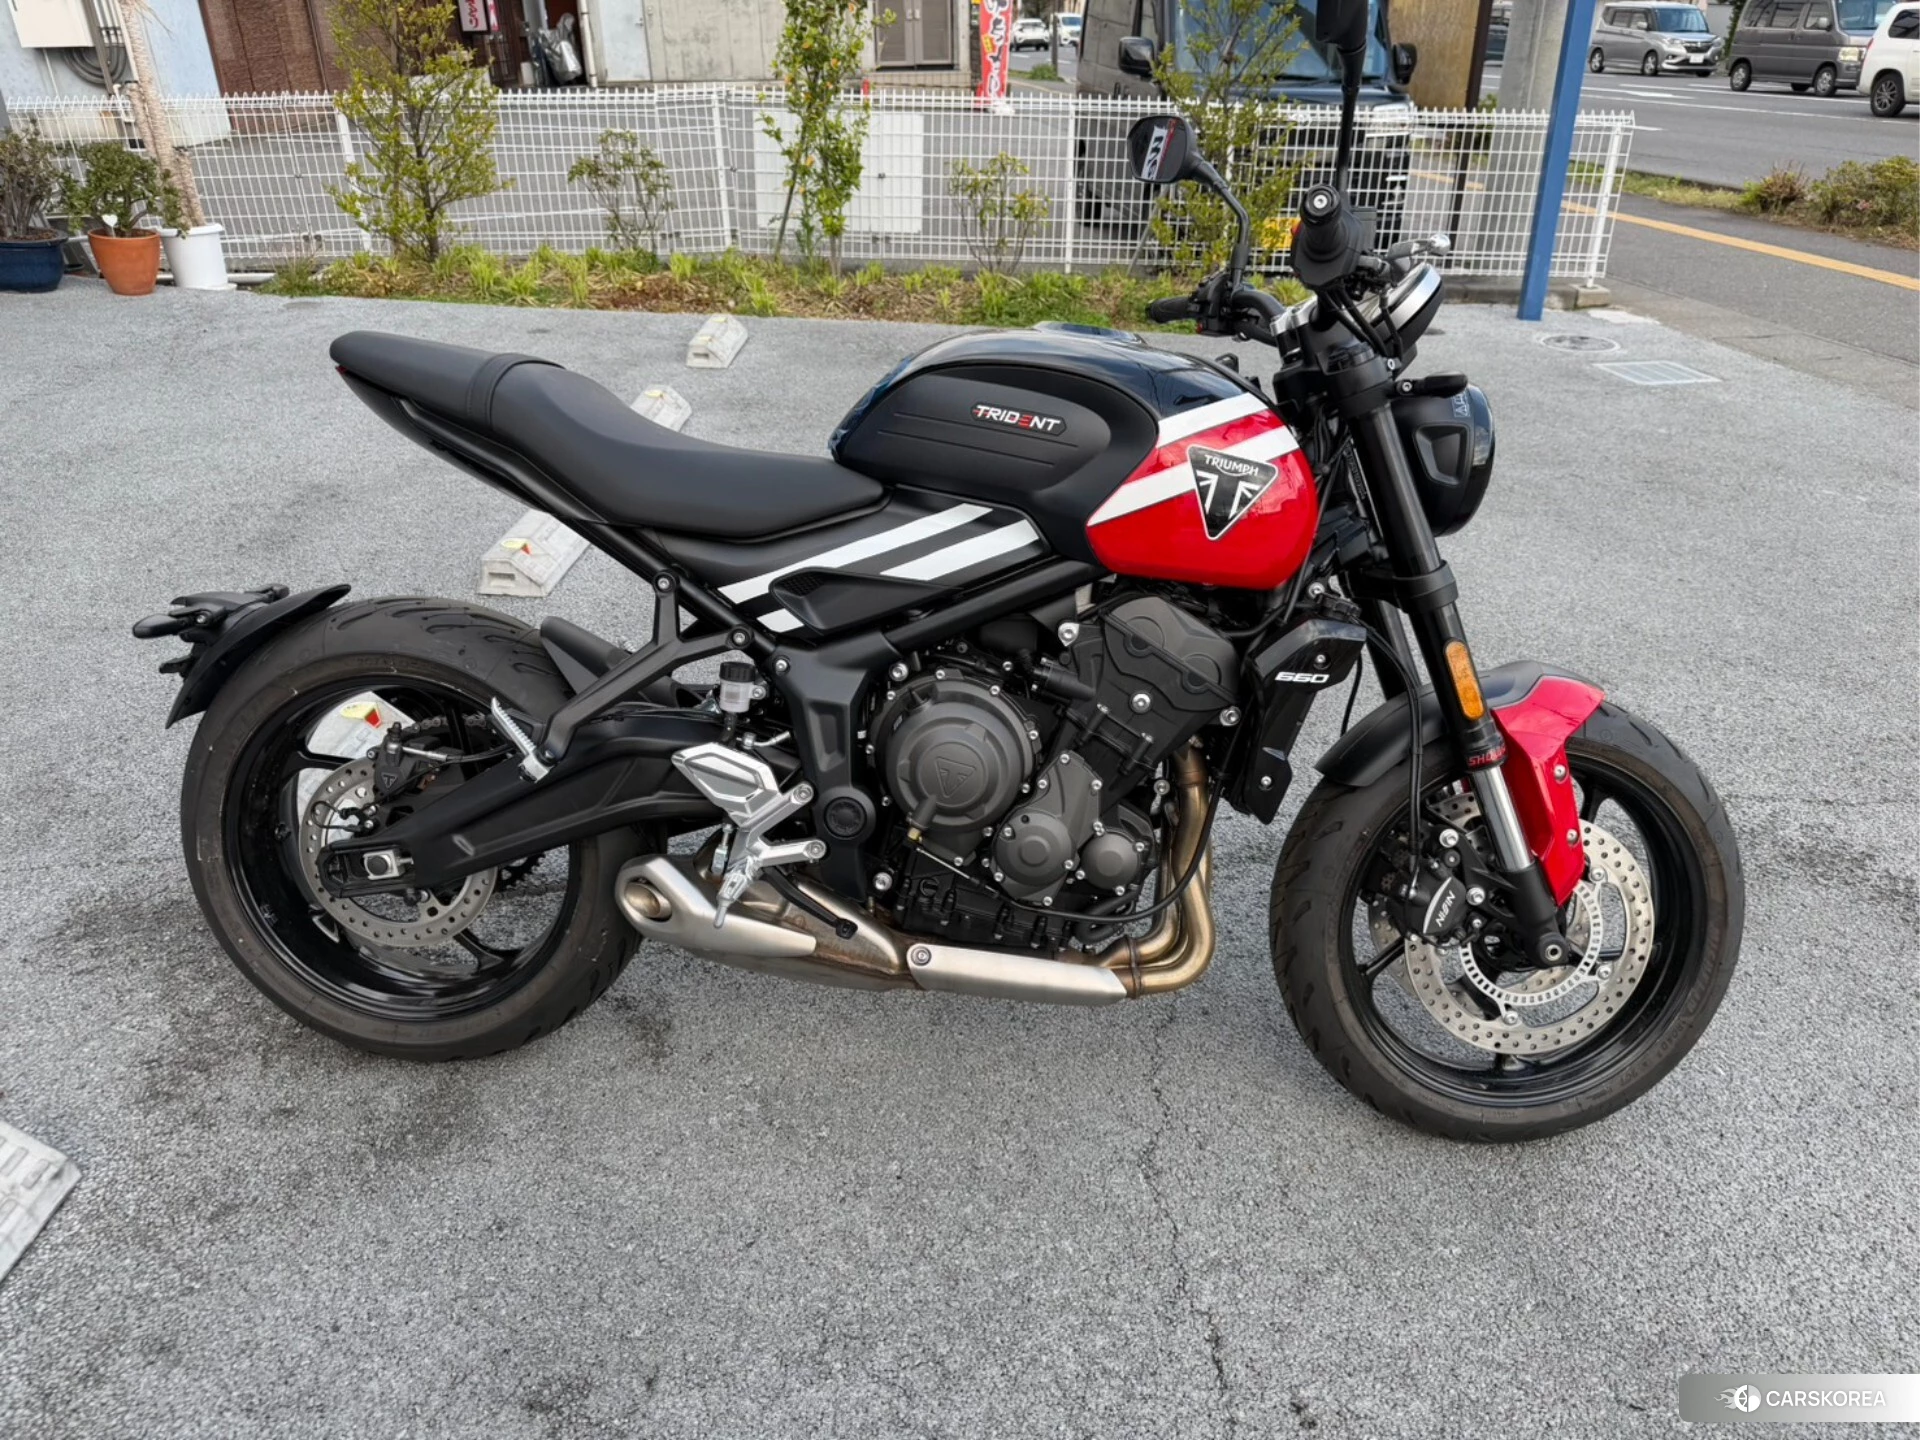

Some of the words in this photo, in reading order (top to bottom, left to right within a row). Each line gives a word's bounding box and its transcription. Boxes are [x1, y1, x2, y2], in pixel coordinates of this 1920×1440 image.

[973, 405, 1060, 431] TRIDENT
[1204, 454, 1259, 477] TRIUMPH
[1275, 671, 1330, 684] 660
